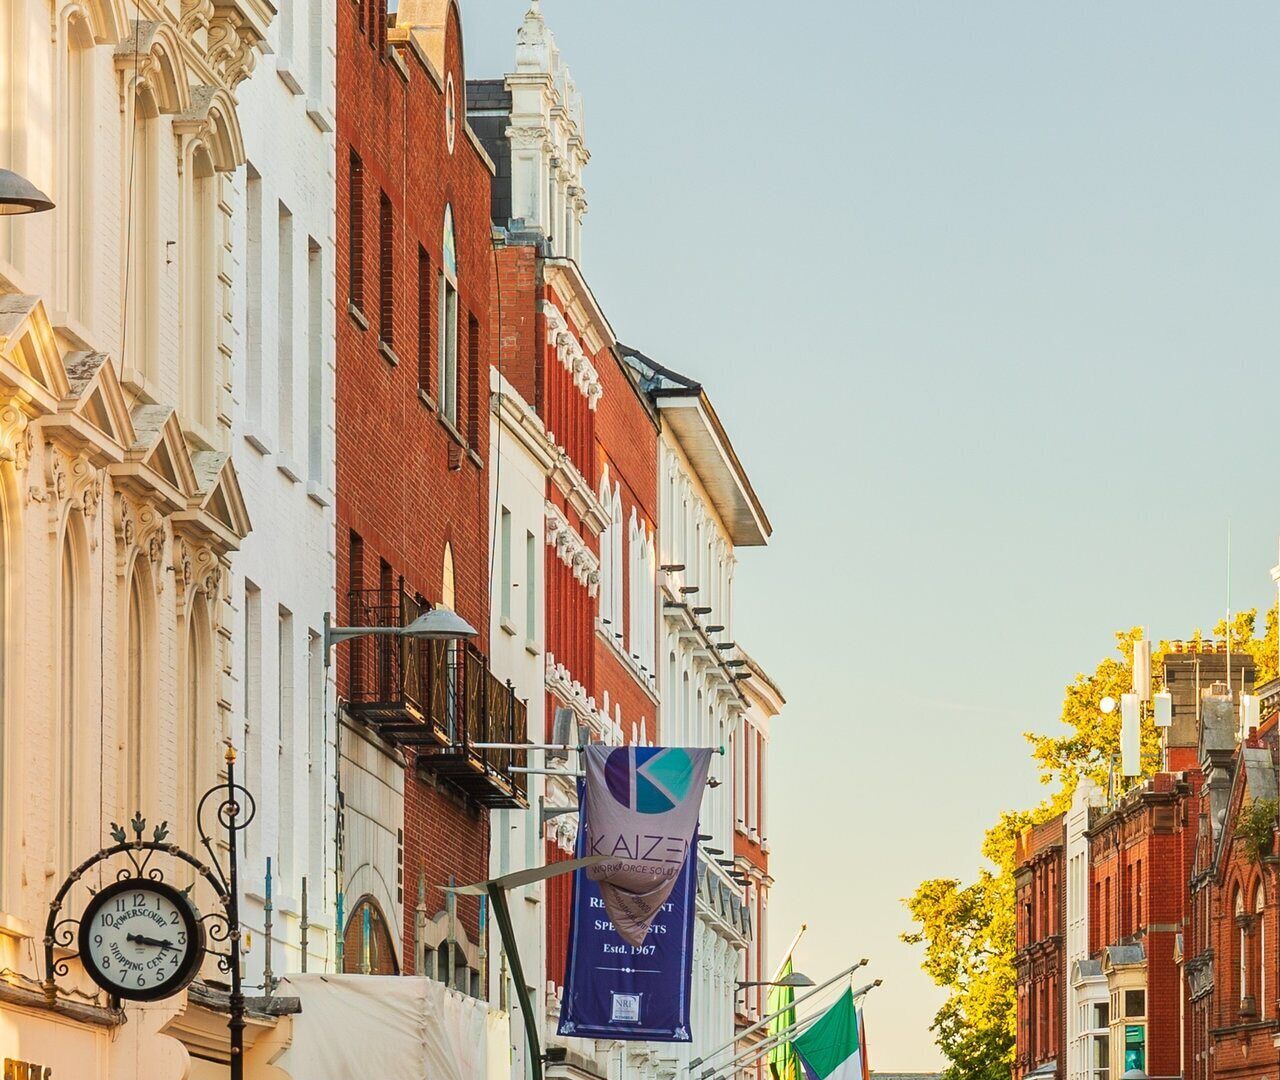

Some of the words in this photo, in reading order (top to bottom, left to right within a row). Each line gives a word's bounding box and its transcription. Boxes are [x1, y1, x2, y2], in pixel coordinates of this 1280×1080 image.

[116, 899, 125, 912] 11
[133, 893, 146, 907] 12
[101, 913, 114, 927] 10
[113, 908, 168, 930] POWERSCOURT
[170, 911, 179, 925] 2
[94, 934, 103, 948] 9
[177, 931, 186, 945] 3
[603, 943, 627, 955] Estd.
[631, 945, 656, 956] 1967
[102, 956, 110, 969] 8
[109, 942, 144, 972] SHOPPING
[146, 947, 170, 970] CENT
[170, 954, 179, 967] 4
[120, 969, 128, 983] 7
[136, 974, 146, 987] 6
[156, 968, 165, 981] 5
